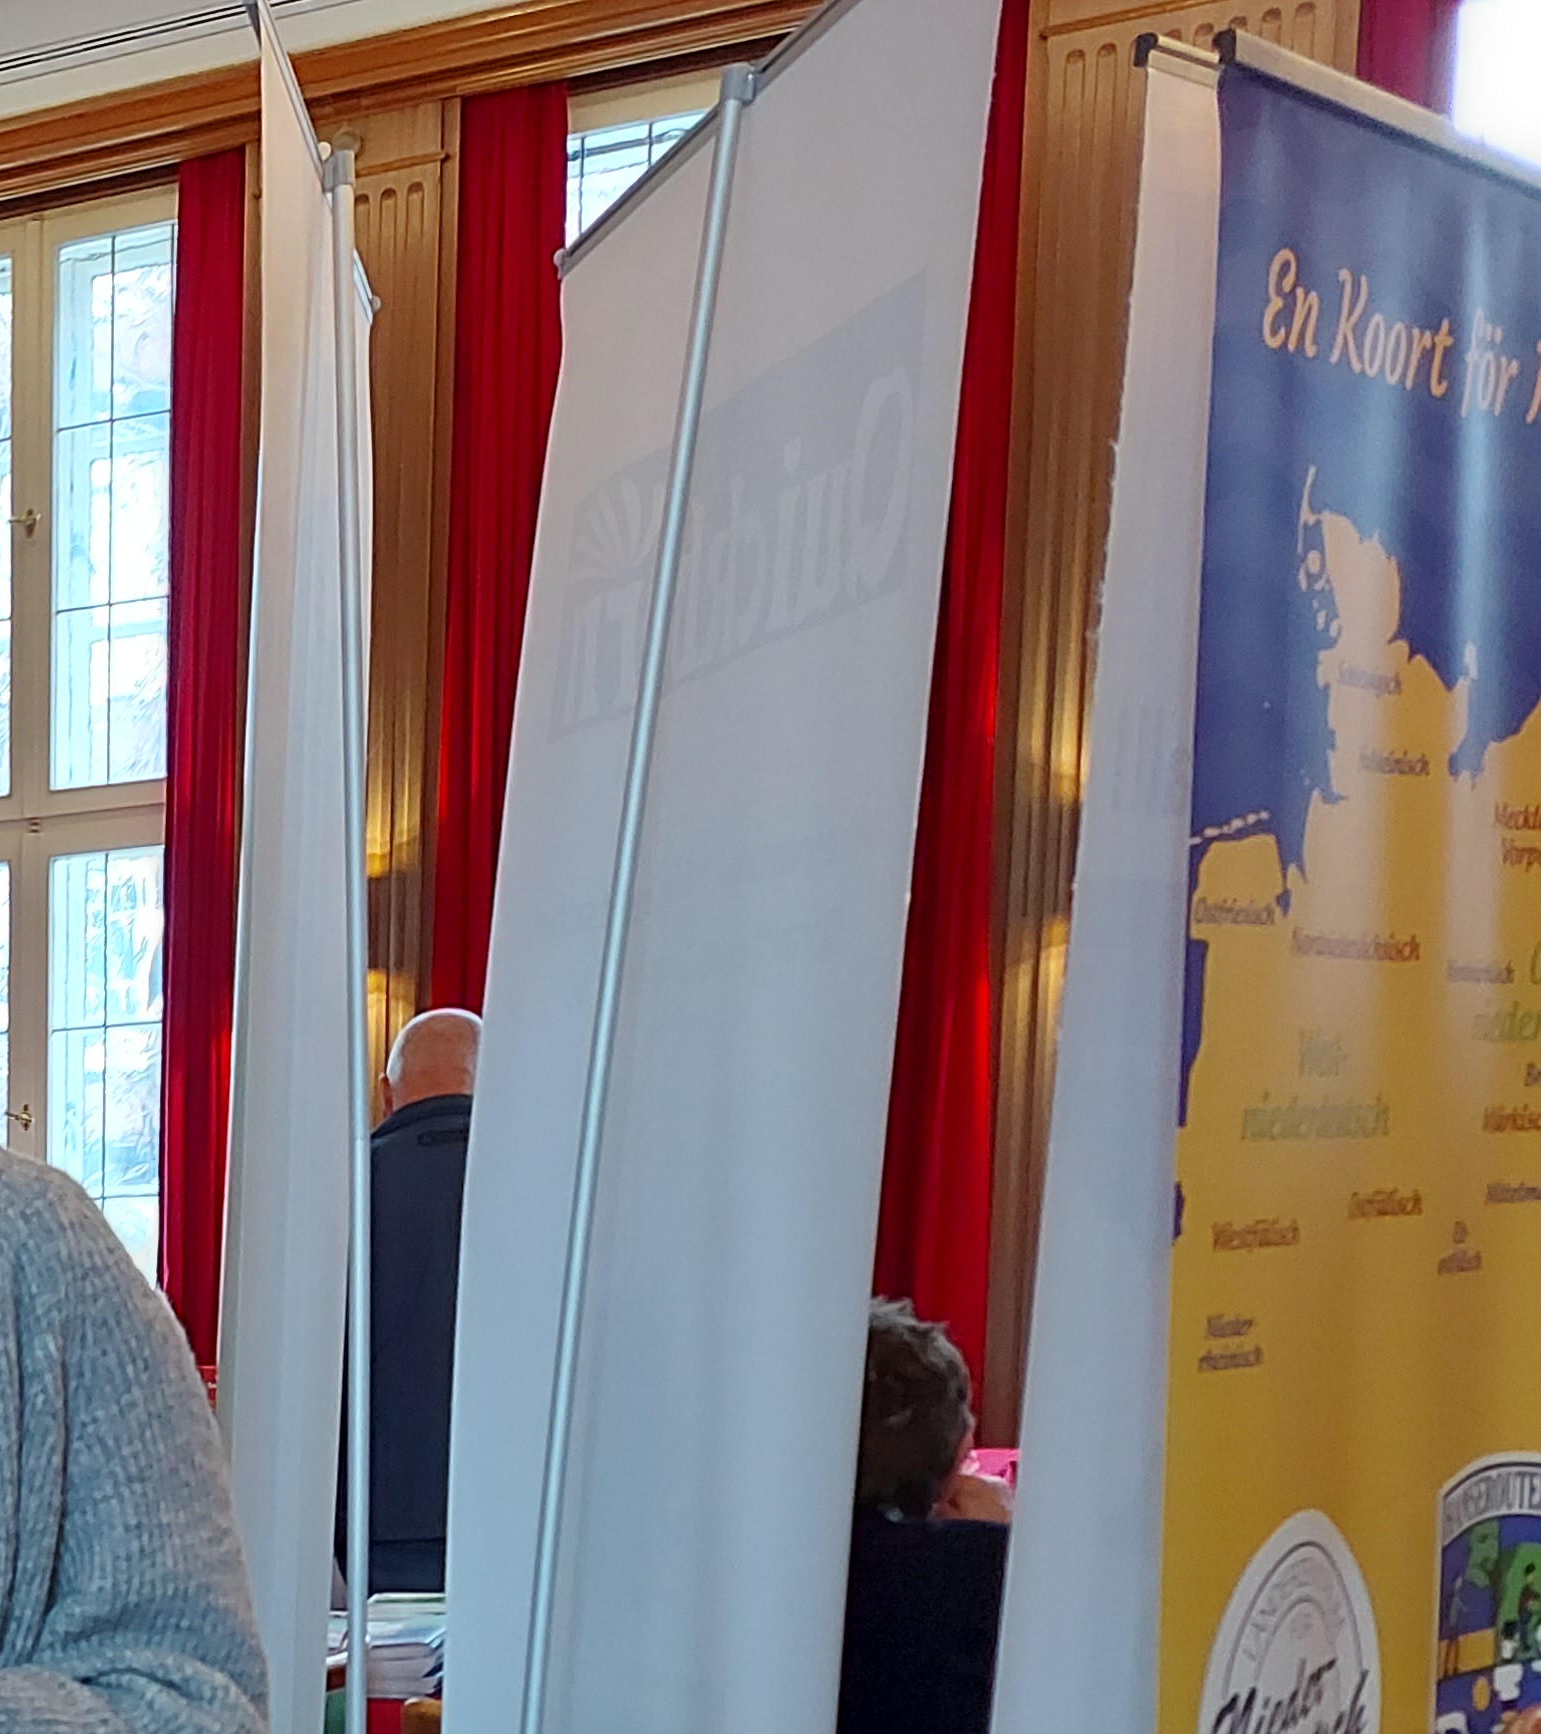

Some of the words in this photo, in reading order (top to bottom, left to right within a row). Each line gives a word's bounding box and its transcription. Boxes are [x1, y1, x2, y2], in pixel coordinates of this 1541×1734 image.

[1263, 248, 1319, 358] En
[1329, 268, 1454, 398] Koort
[1461, 308, 1520, 418] för
